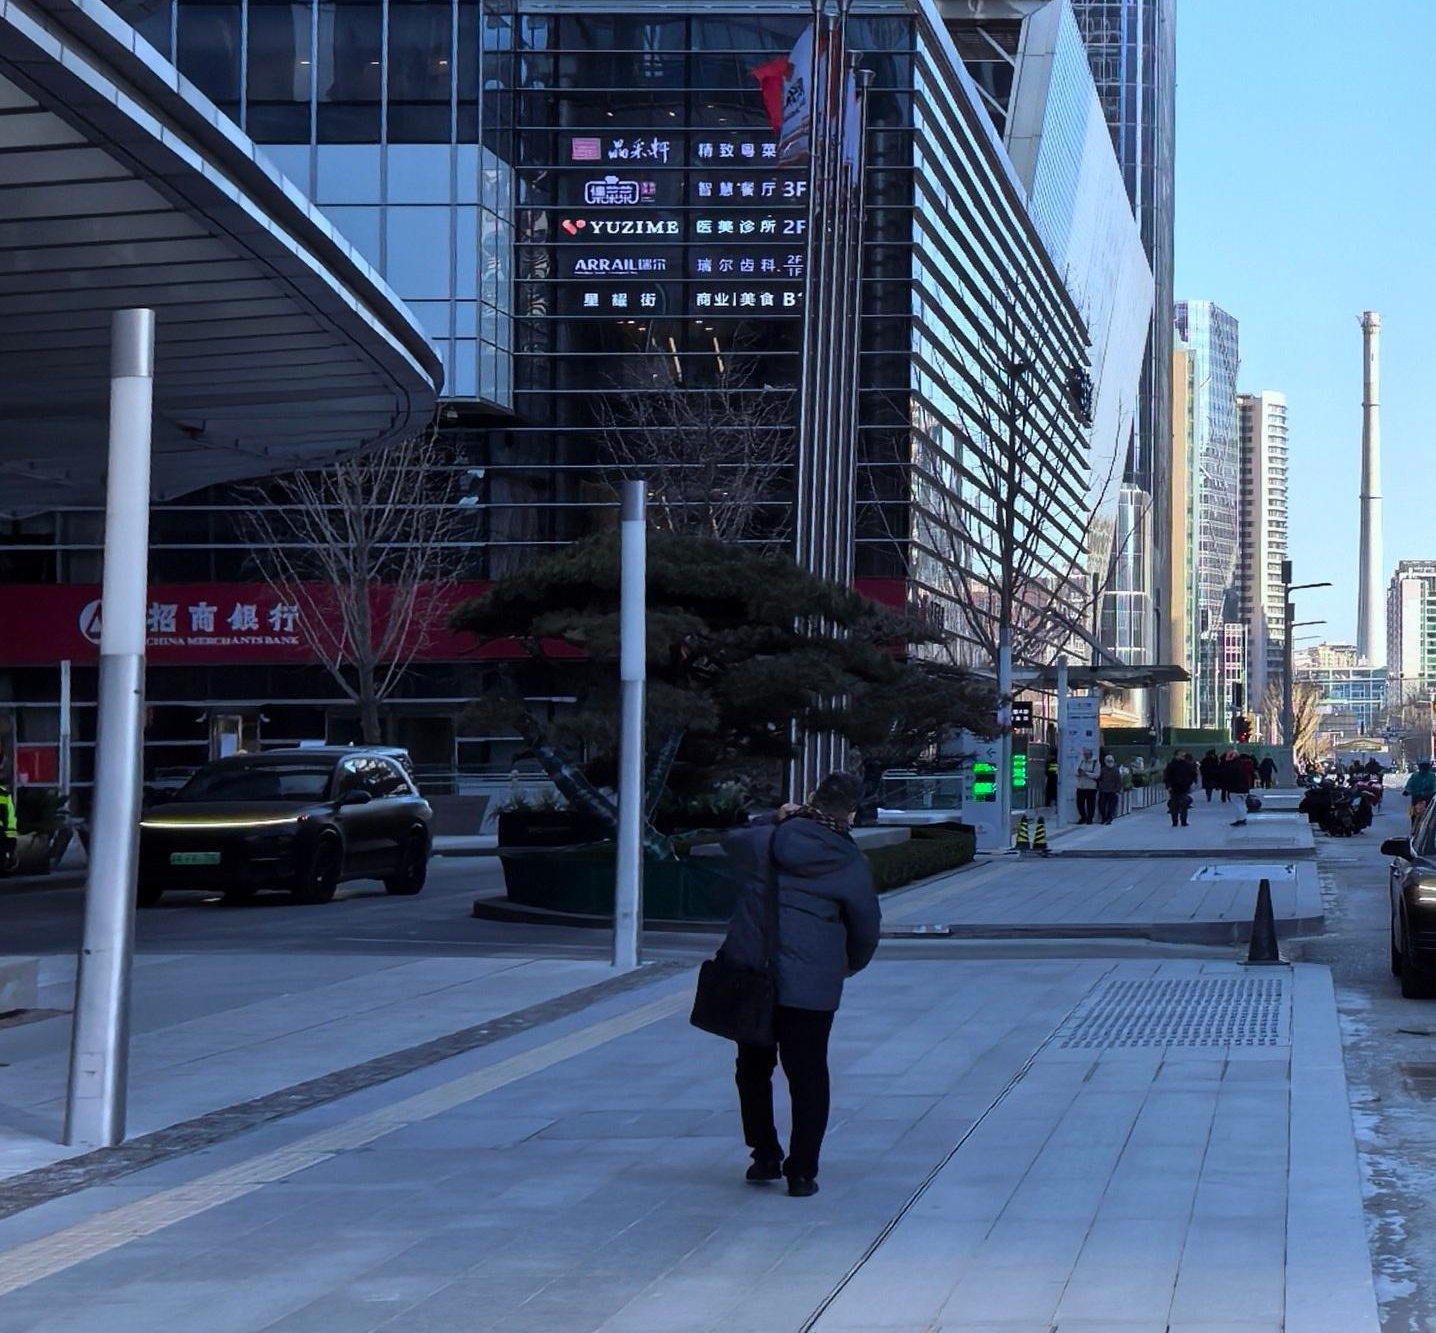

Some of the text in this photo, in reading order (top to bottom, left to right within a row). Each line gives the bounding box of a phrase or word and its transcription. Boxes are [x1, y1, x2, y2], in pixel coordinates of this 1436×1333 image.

[783, 181, 807, 197] 3F
[590, 220, 679, 234] YUZIME
[696, 220, 806, 234] 医美诊所 2F
[697, 258, 776, 272] 瑞尔齿科
